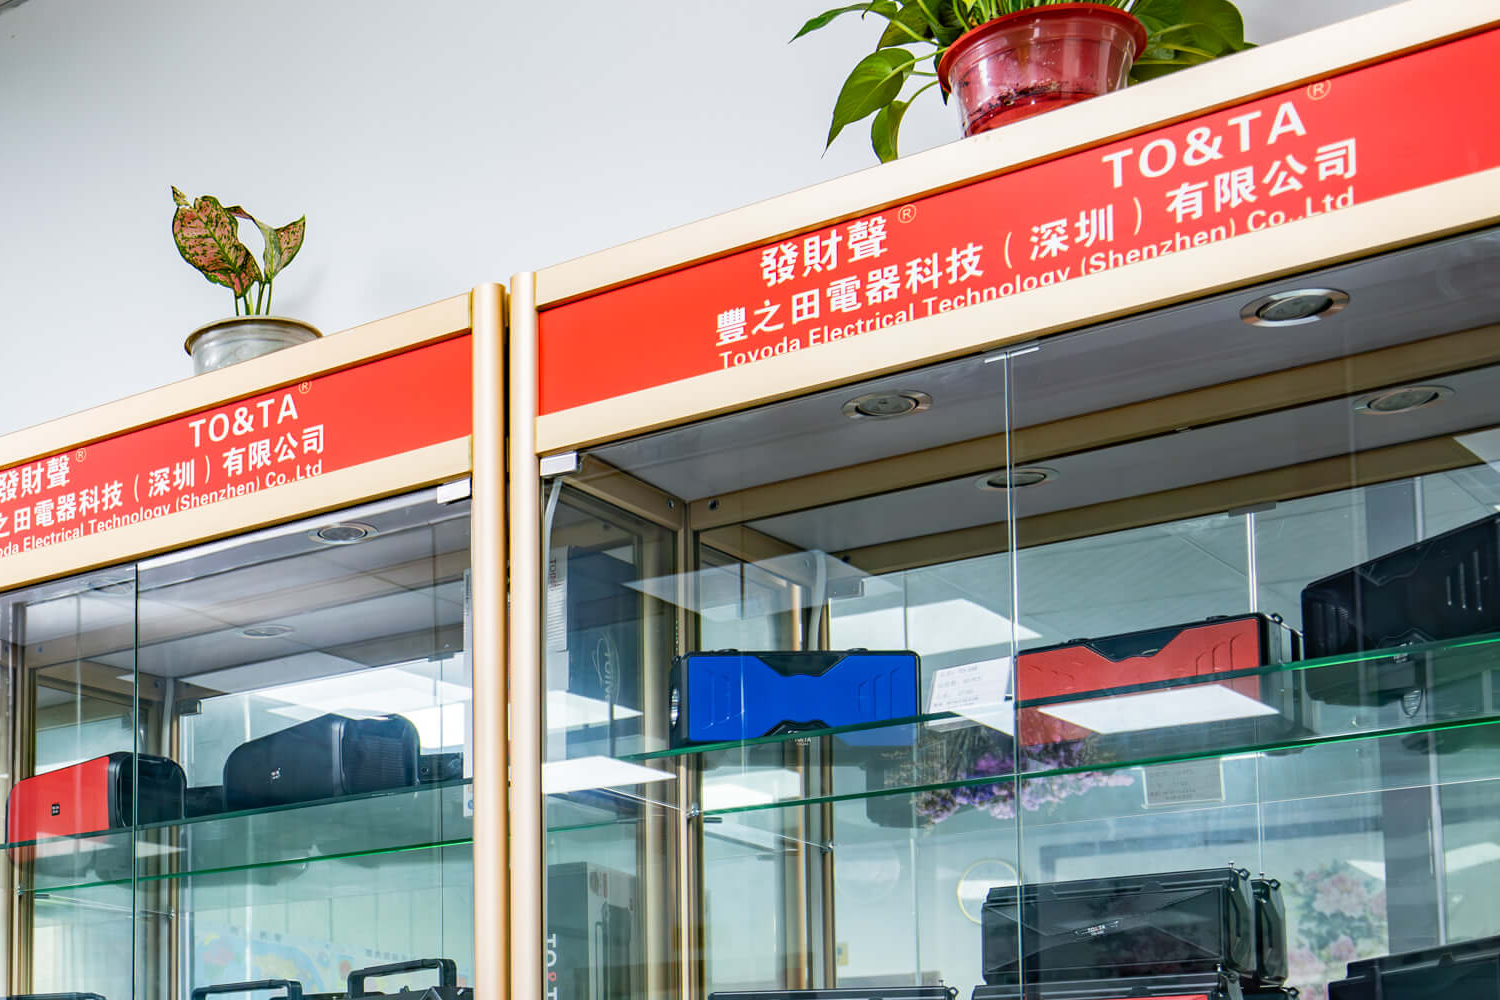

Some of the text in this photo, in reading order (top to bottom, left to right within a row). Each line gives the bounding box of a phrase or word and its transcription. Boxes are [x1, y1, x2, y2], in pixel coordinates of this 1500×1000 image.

[1102, 101, 1306, 189] TO&TA
[760, 215, 889, 288] 發財聲
[809, 304, 915, 348] Electrical
[1080, 217, 1236, 277] (Shenzhen)
[188, 393, 298, 448] TO&TA
[23, 525, 84, 552] Electrical
[175, 479, 260, 517] (Shenzhen)
